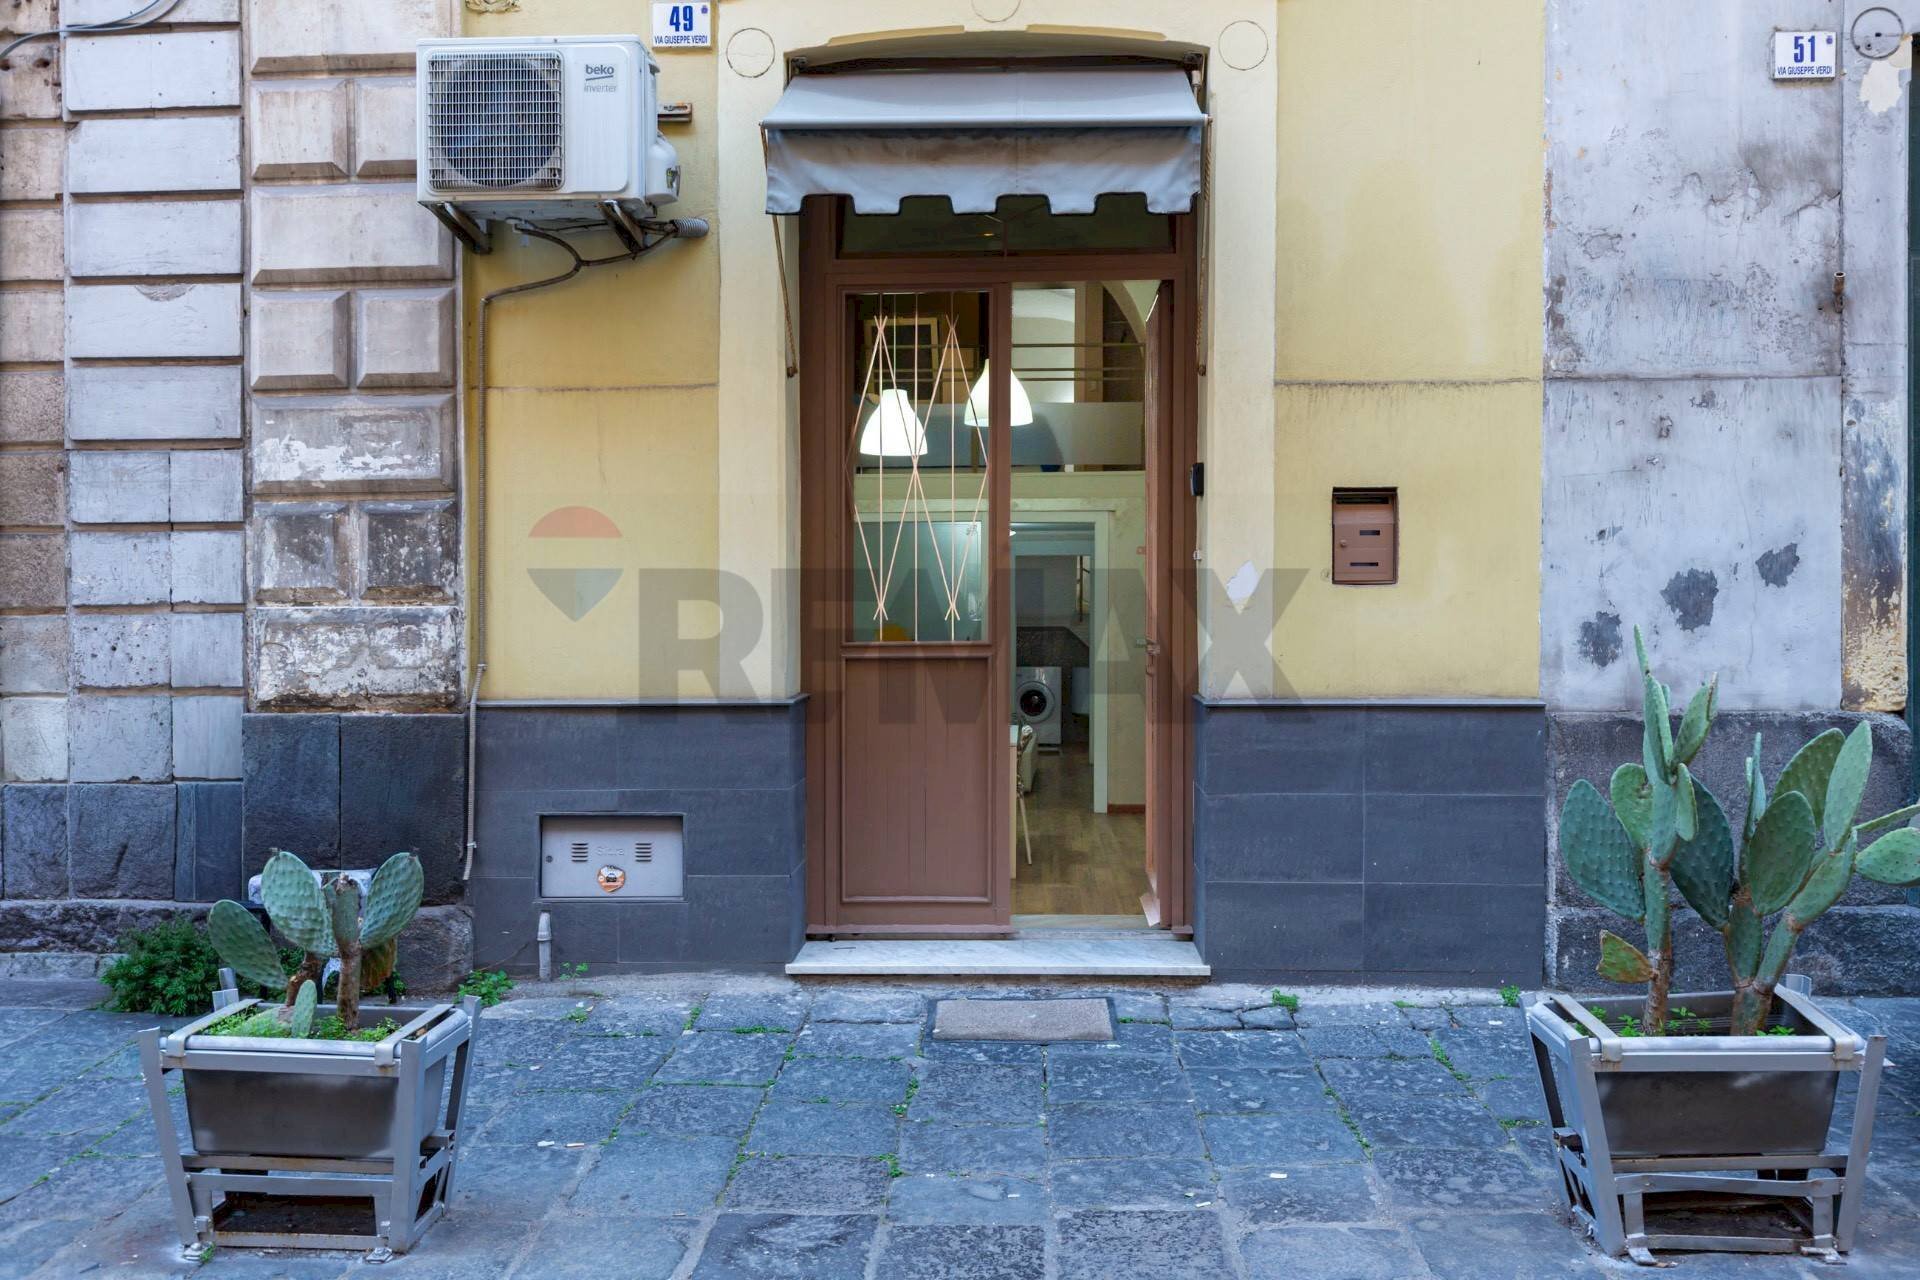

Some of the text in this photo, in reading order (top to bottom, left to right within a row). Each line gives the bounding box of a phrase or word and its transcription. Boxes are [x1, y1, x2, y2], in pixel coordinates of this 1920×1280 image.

[669, 5, 694, 32] 49
[654, 35, 708, 44] VIA GIUSEPPE VERDI
[1793, 35, 1816, 63] 51
[585, 64, 615, 75] beko
[1777, 65, 1833, 75] VIA GIUSEPPE VERDI
